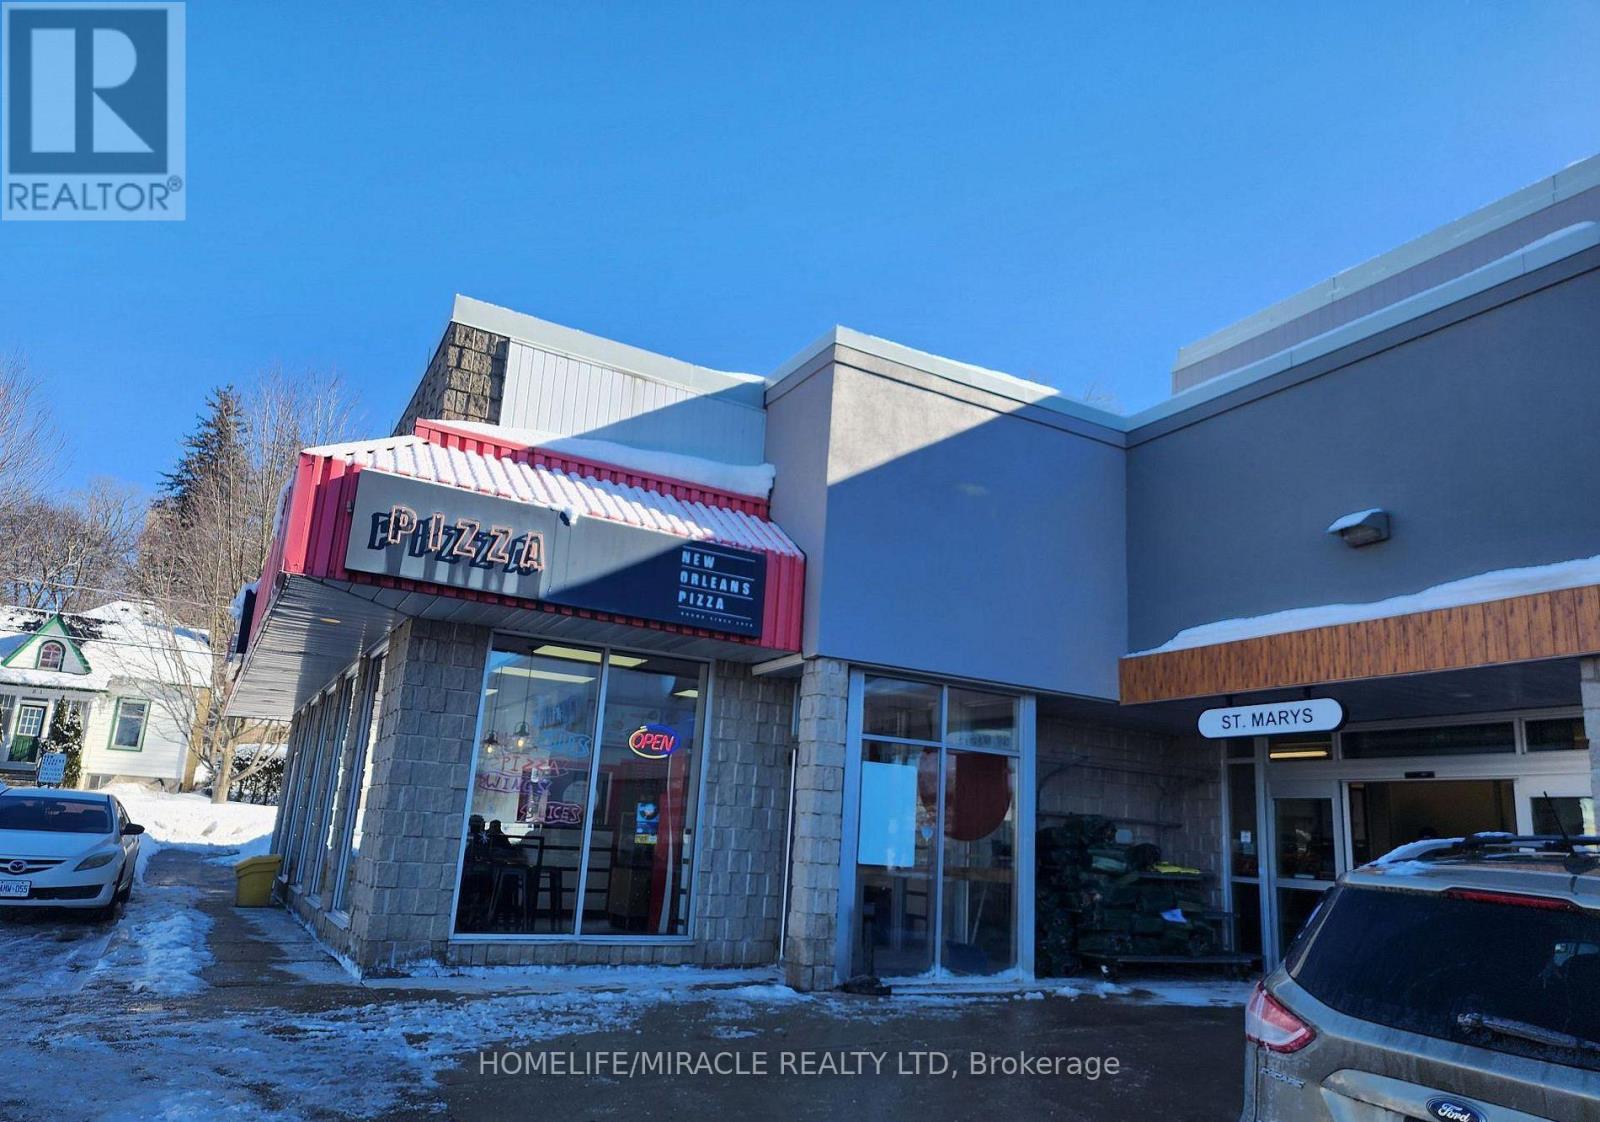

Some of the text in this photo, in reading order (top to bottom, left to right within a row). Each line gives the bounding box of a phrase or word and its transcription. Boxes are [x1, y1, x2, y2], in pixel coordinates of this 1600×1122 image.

[386, 504, 546, 572] PIZZA
[681, 551, 715, 569] NEW
[680, 570, 751, 595] ORLEANS
[678, 590, 724, 610] PIZZA
[1221, 707, 1313, 729] ST. MARYS
[631, 733, 675, 752] OPEN
[1438, 1103, 1471, 1122] Ford
